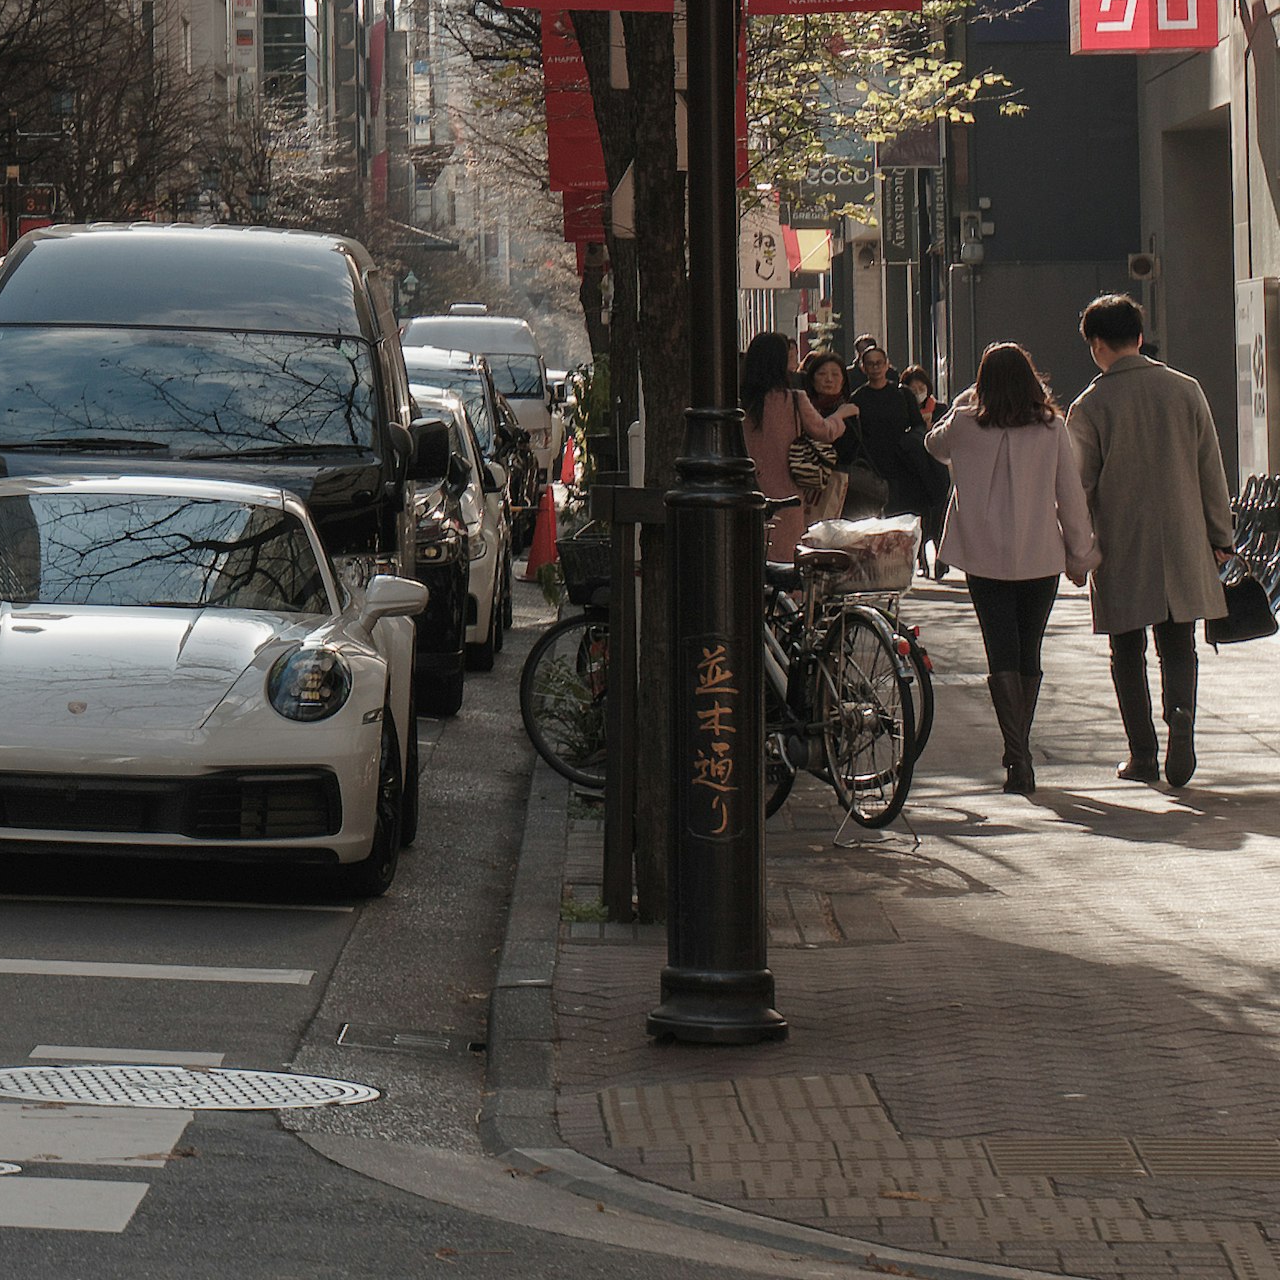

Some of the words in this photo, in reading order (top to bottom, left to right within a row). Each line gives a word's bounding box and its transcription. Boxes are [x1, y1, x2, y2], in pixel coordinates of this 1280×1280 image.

[554, 55, 581, 63] HAPPY
[692, 644, 740, 835] 並木通り
